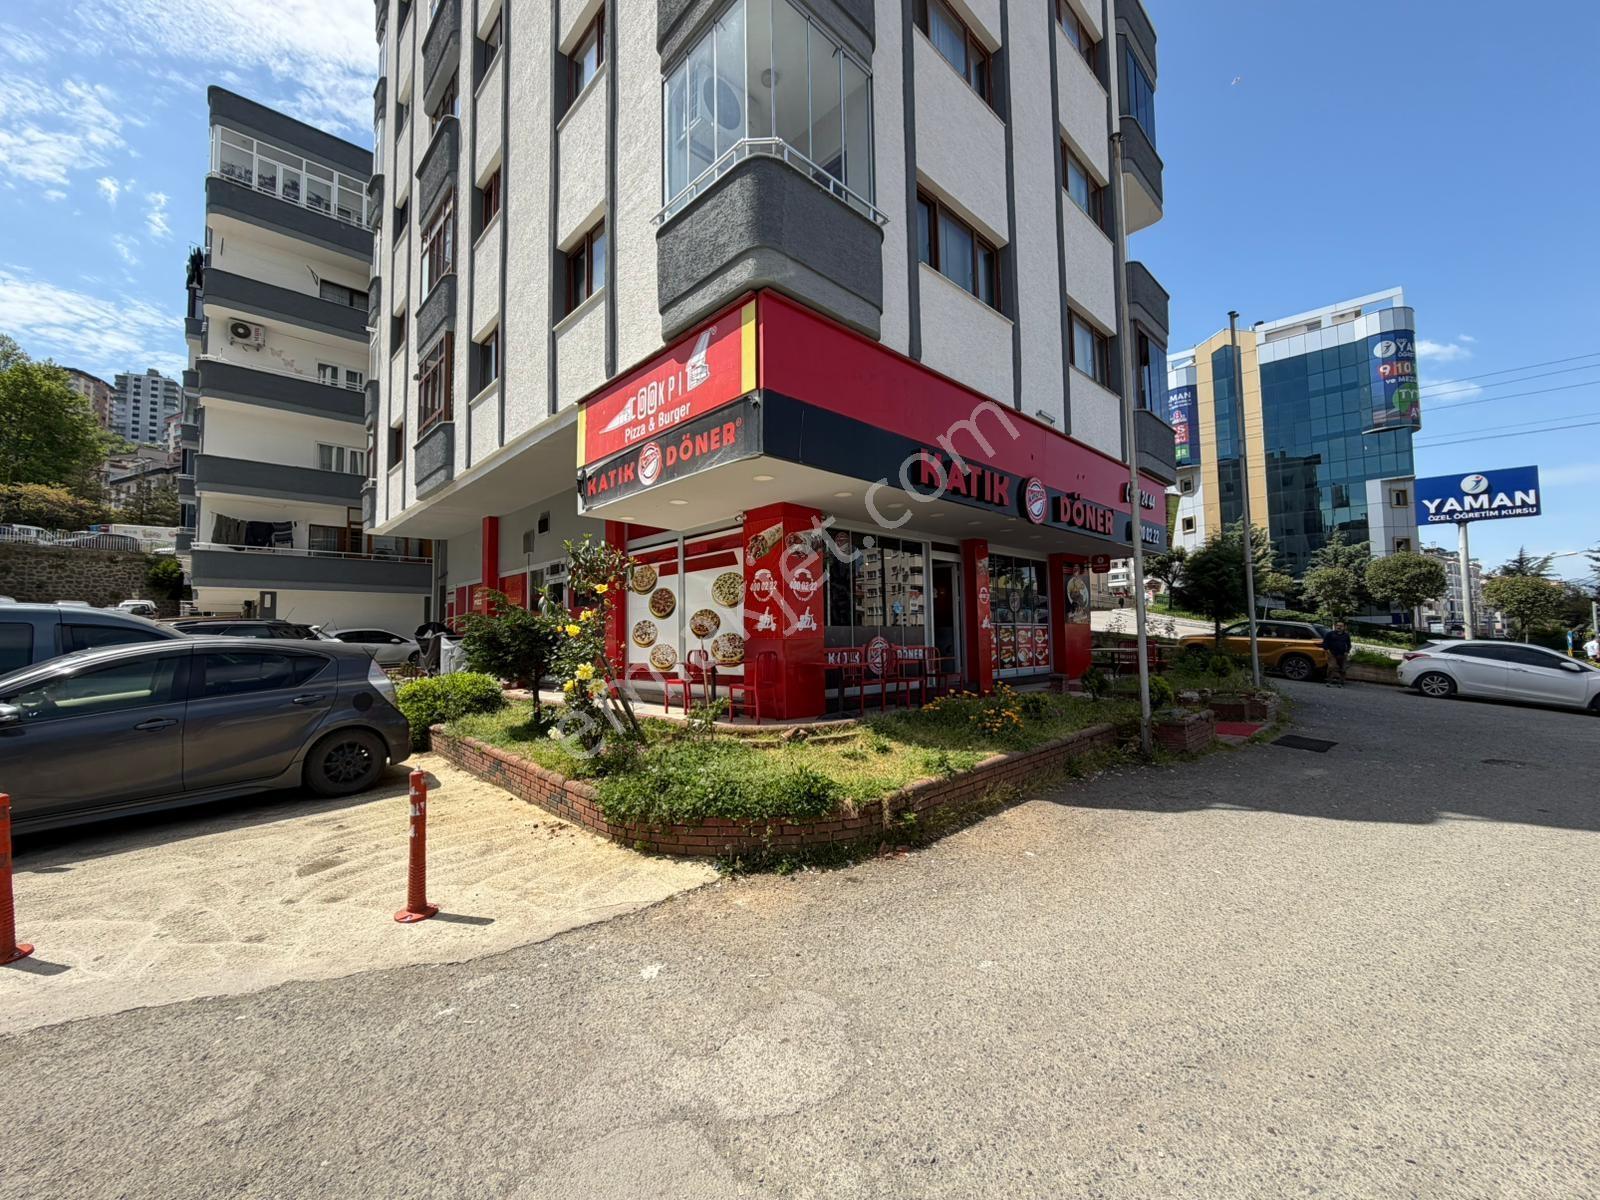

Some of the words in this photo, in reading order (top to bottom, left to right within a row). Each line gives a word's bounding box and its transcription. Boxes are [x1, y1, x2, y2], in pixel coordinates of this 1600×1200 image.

[1379, 364, 1391, 376] 9
[1168, 391, 1192, 403] MAN
[624, 424, 646, 444] Pizza
[648, 418, 655, 432] &
[658, 402, 691, 428] Burger
[587, 461, 636, 497] KATIK
[920, 448, 1010, 507] KATIK
[1060, 491, 1114, 535] DÖNER
[1422, 489, 1537, 514] YAMAN
[1428, 514, 1452, 522] ÖZEL
[1454, 510, 1498, 520] ÖĞRETİM
[1501, 507, 1537, 516] KURSU
